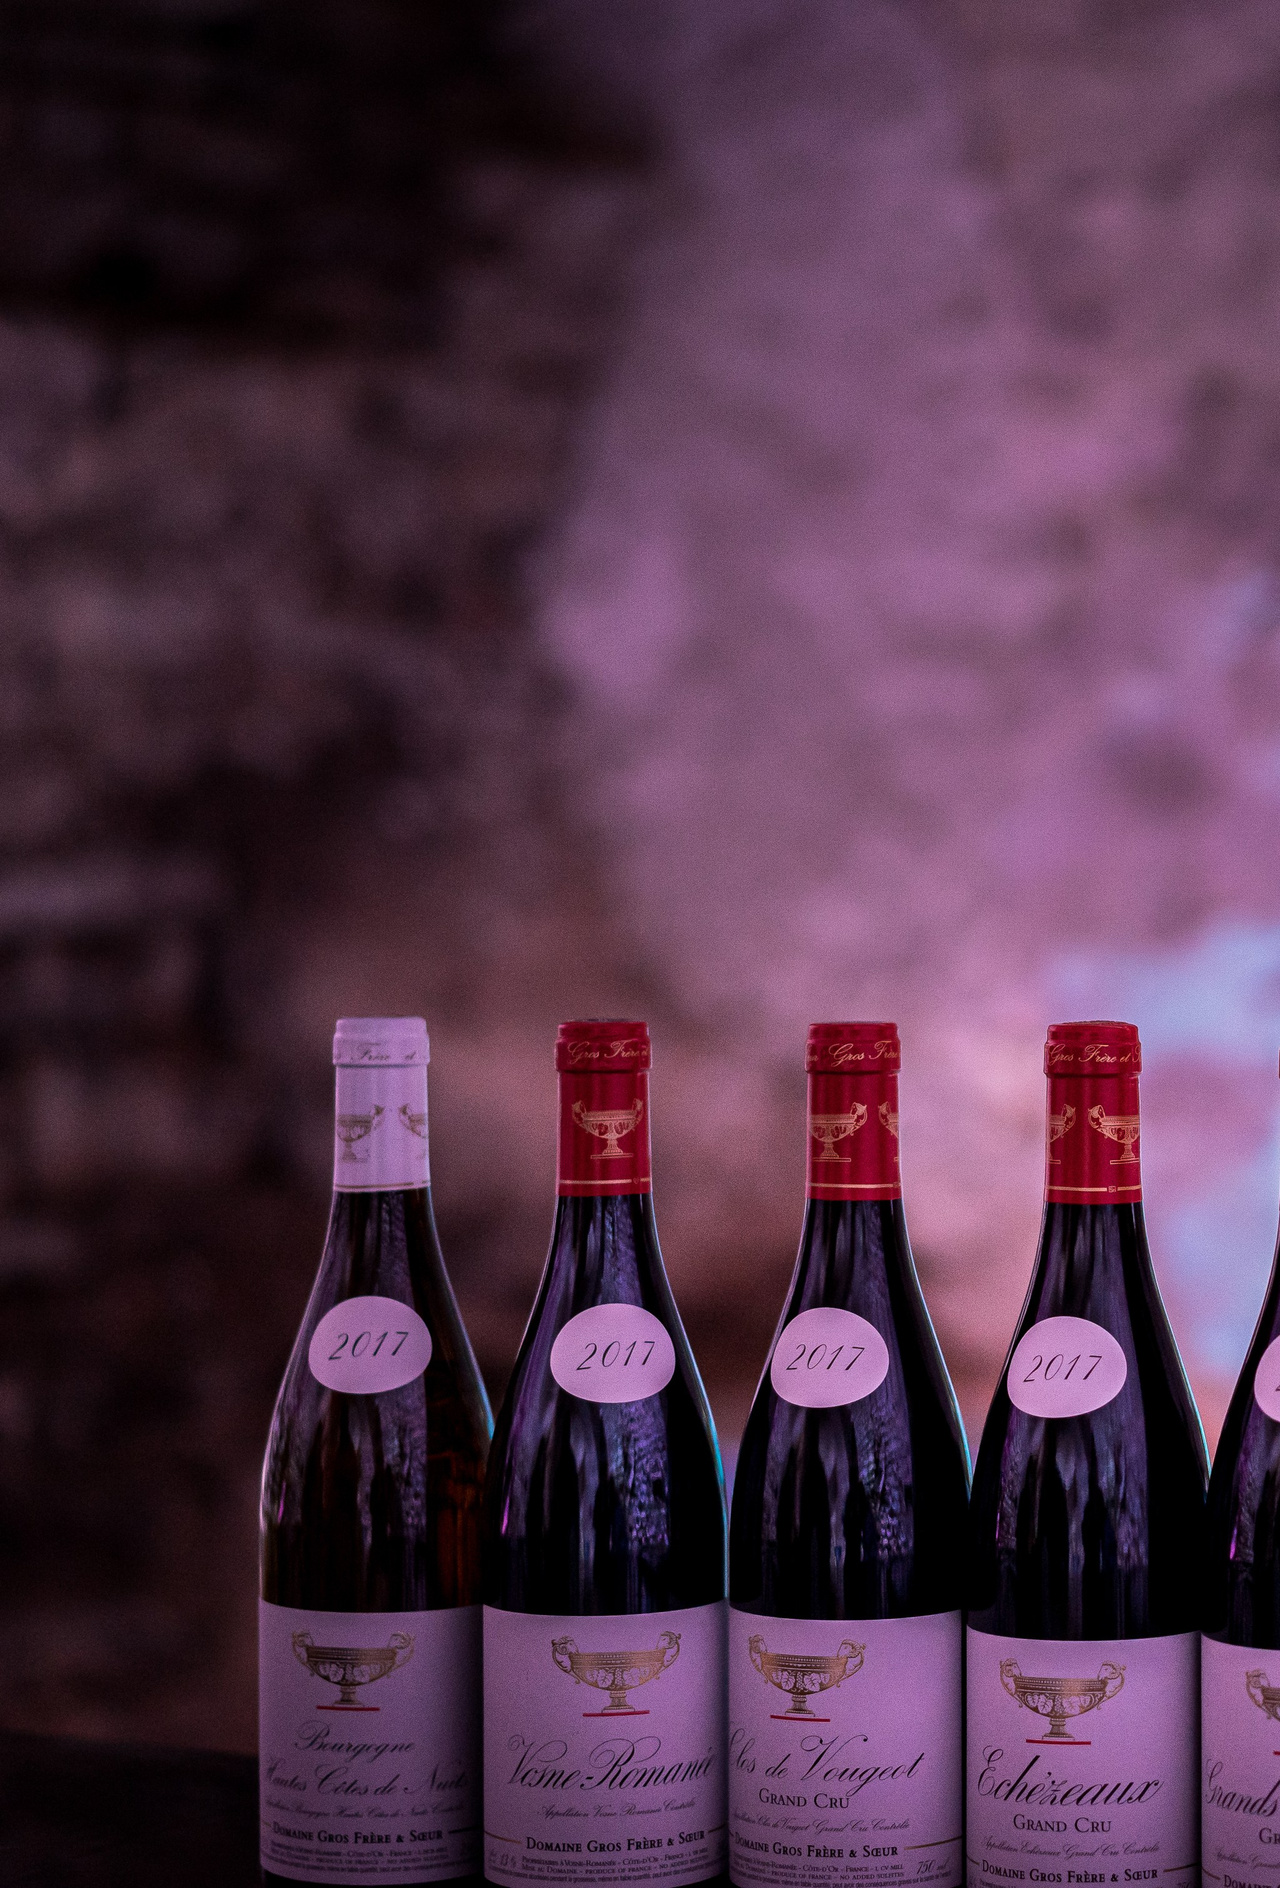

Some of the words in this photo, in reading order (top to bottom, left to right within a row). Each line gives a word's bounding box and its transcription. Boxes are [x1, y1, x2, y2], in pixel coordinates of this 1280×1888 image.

[568, 1041, 600, 1064] Gros
[828, 1043, 865, 1067] Gros
[1048, 1044, 1074, 1066] Gros
[1079, 1044, 1118, 1062] Frère
[1120, 1053, 1132, 1063] et
[328, 1331, 409, 1361] 2017
[576, 1340, 656, 1371] 2017
[786, 1343, 865, 1371] 2017
[1023, 1354, 1103, 1383] 2017
[294, 1719, 417, 1763] Bourgogne
[765, 1752, 792, 1780] de
[800, 1734, 925, 1798] Vougeot
[314, 1763, 370, 1796] Côtes
[373, 1773, 400, 1795] de
[758, 1787, 807, 1808] GRAND
[814, 1793, 850, 1809] CRU
[273, 1820, 314, 1841] DOMAINE
[317, 1830, 350, 1844] GROS
[354, 1831, 392, 1844] FRÈRE
[396, 1833, 404, 1843] &
[1013, 1814, 1068, 1833] GRAND
[1074, 1817, 1112, 1833] CRU
[526, 1836, 582, 1852] DOMAINE
[586, 1839, 622, 1853] GROS
[627, 1835, 663, 1851] FRÈRE
[667, 1838, 675, 1847] &
[735, 1832, 769, 1853] DOMAINE
[772, 1841, 803, 1857] GROS
[807, 1844, 844, 1858] FRÈRE
[849, 1849, 857, 1858] &
[862, 1844, 899, 1858] SŒUR
[917, 1859, 937, 1875] 750
[982, 1859, 1025, 1880] DOMAINE
[1029, 1867, 1062, 1882] GROS
[1067, 1869, 1105, 1883] FRÈRE
[1110, 1872, 1118, 1882] &
[1124, 1868, 1158, 1881] SŒUR
